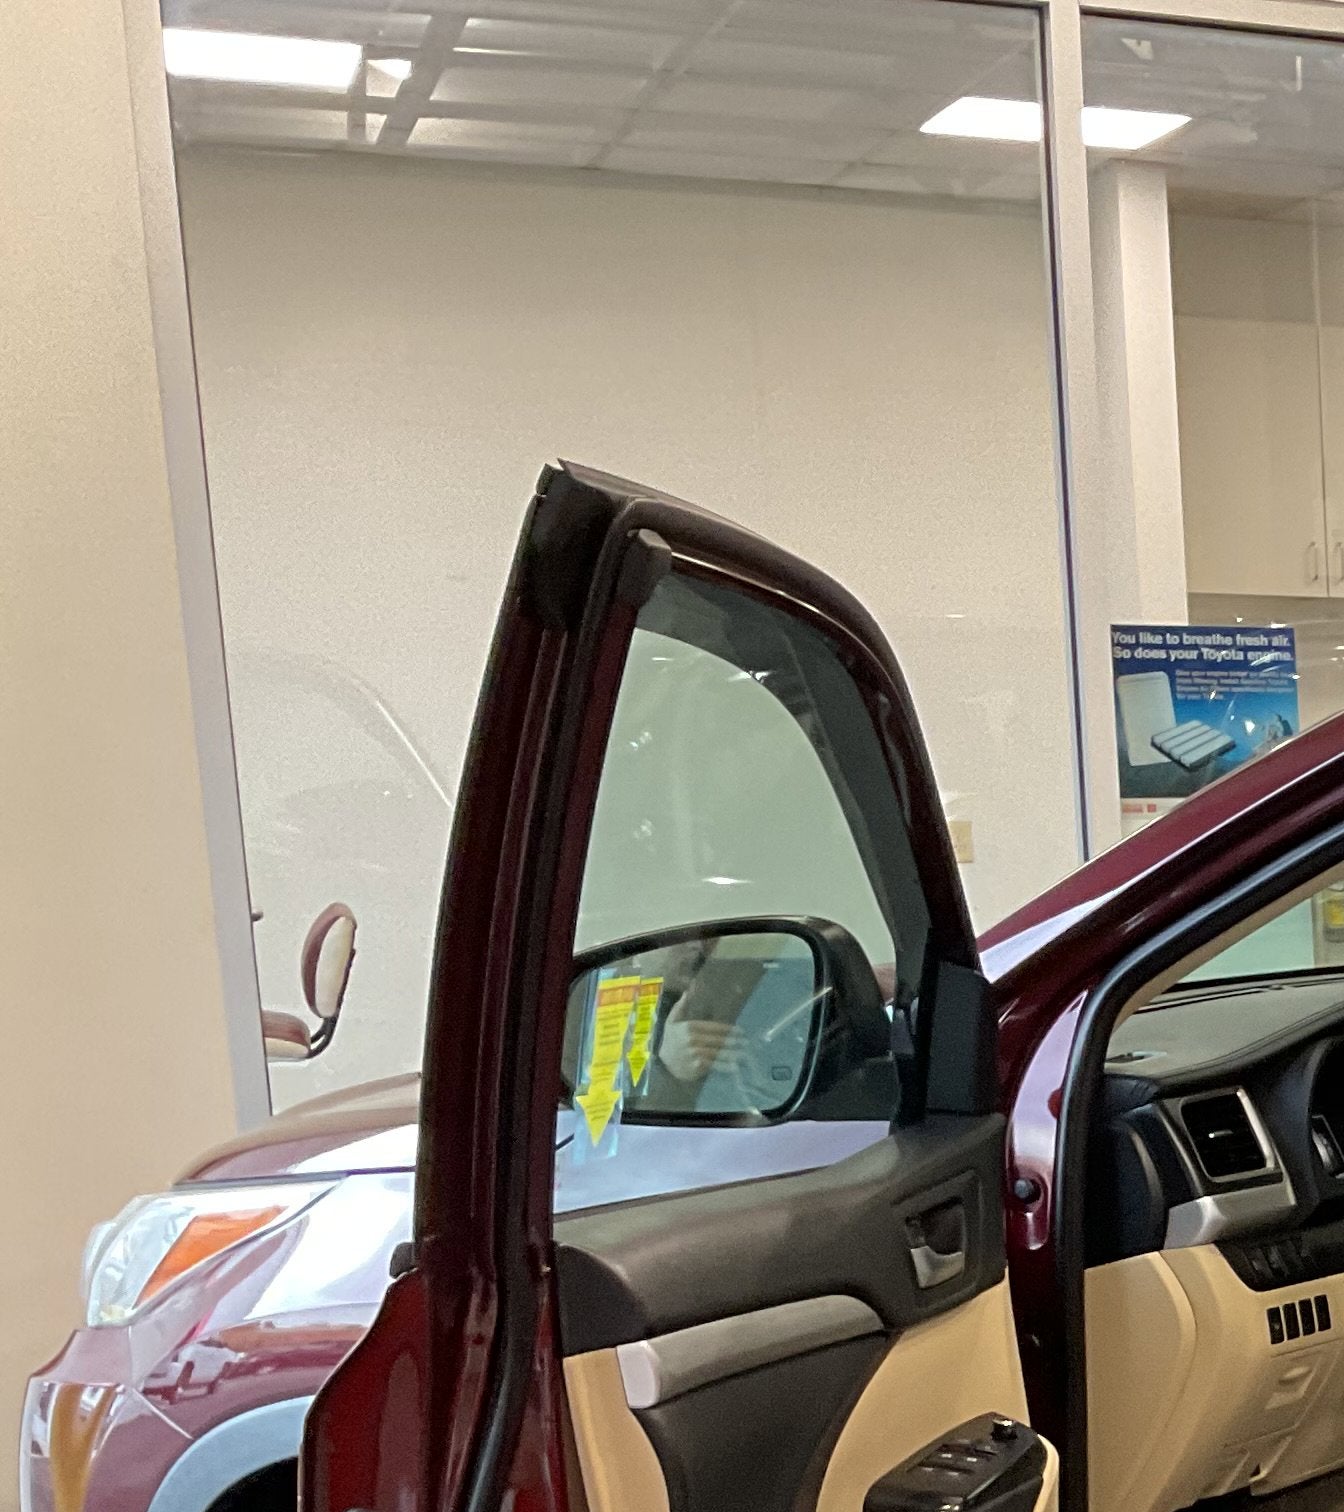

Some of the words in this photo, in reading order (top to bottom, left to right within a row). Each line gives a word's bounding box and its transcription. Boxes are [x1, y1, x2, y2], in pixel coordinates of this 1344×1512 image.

[1112, 631, 1136, 644] You
[1139, 631, 1163, 644] like
[1166, 632, 1180, 645] to
[1183, 632, 1233, 646] breathe
[1236, 633, 1269, 647] fresh
[1271, 634, 1291, 647] air.
[1113, 646, 1132, 659] So
[1134, 647, 1167, 660] does
[1169, 648, 1199, 662] your
[1200, 648, 1244, 663] Toyota
[1247, 650, 1294, 662] engine.
